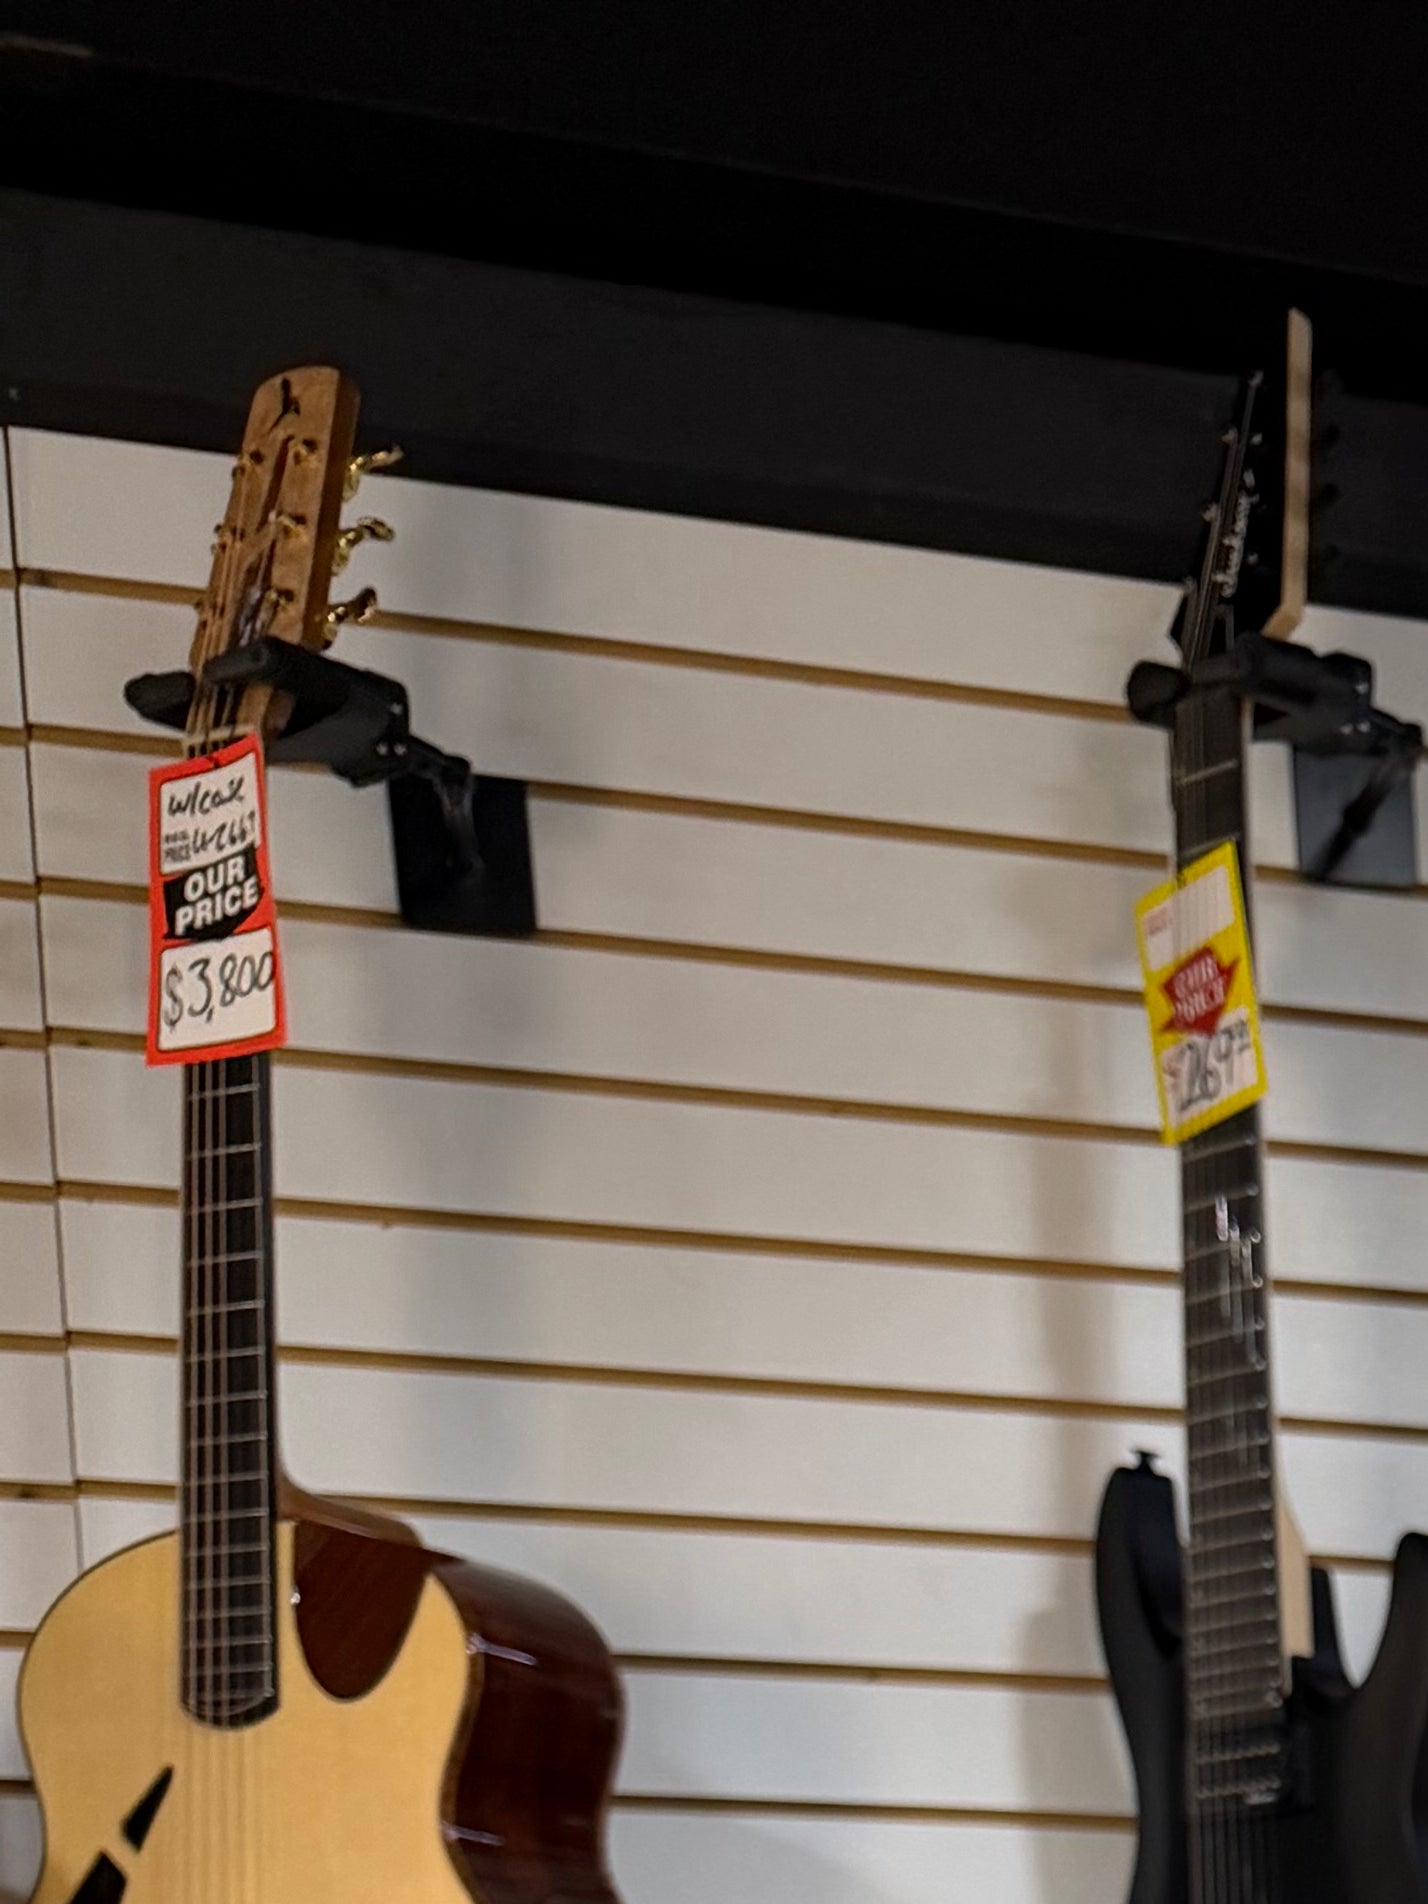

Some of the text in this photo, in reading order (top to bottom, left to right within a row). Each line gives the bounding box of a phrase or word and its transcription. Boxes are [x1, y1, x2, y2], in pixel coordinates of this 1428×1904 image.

[175, 873, 260, 937] PRICE
[184, 855, 246, 902] OUR
[162, 951, 275, 1034] $3,800
